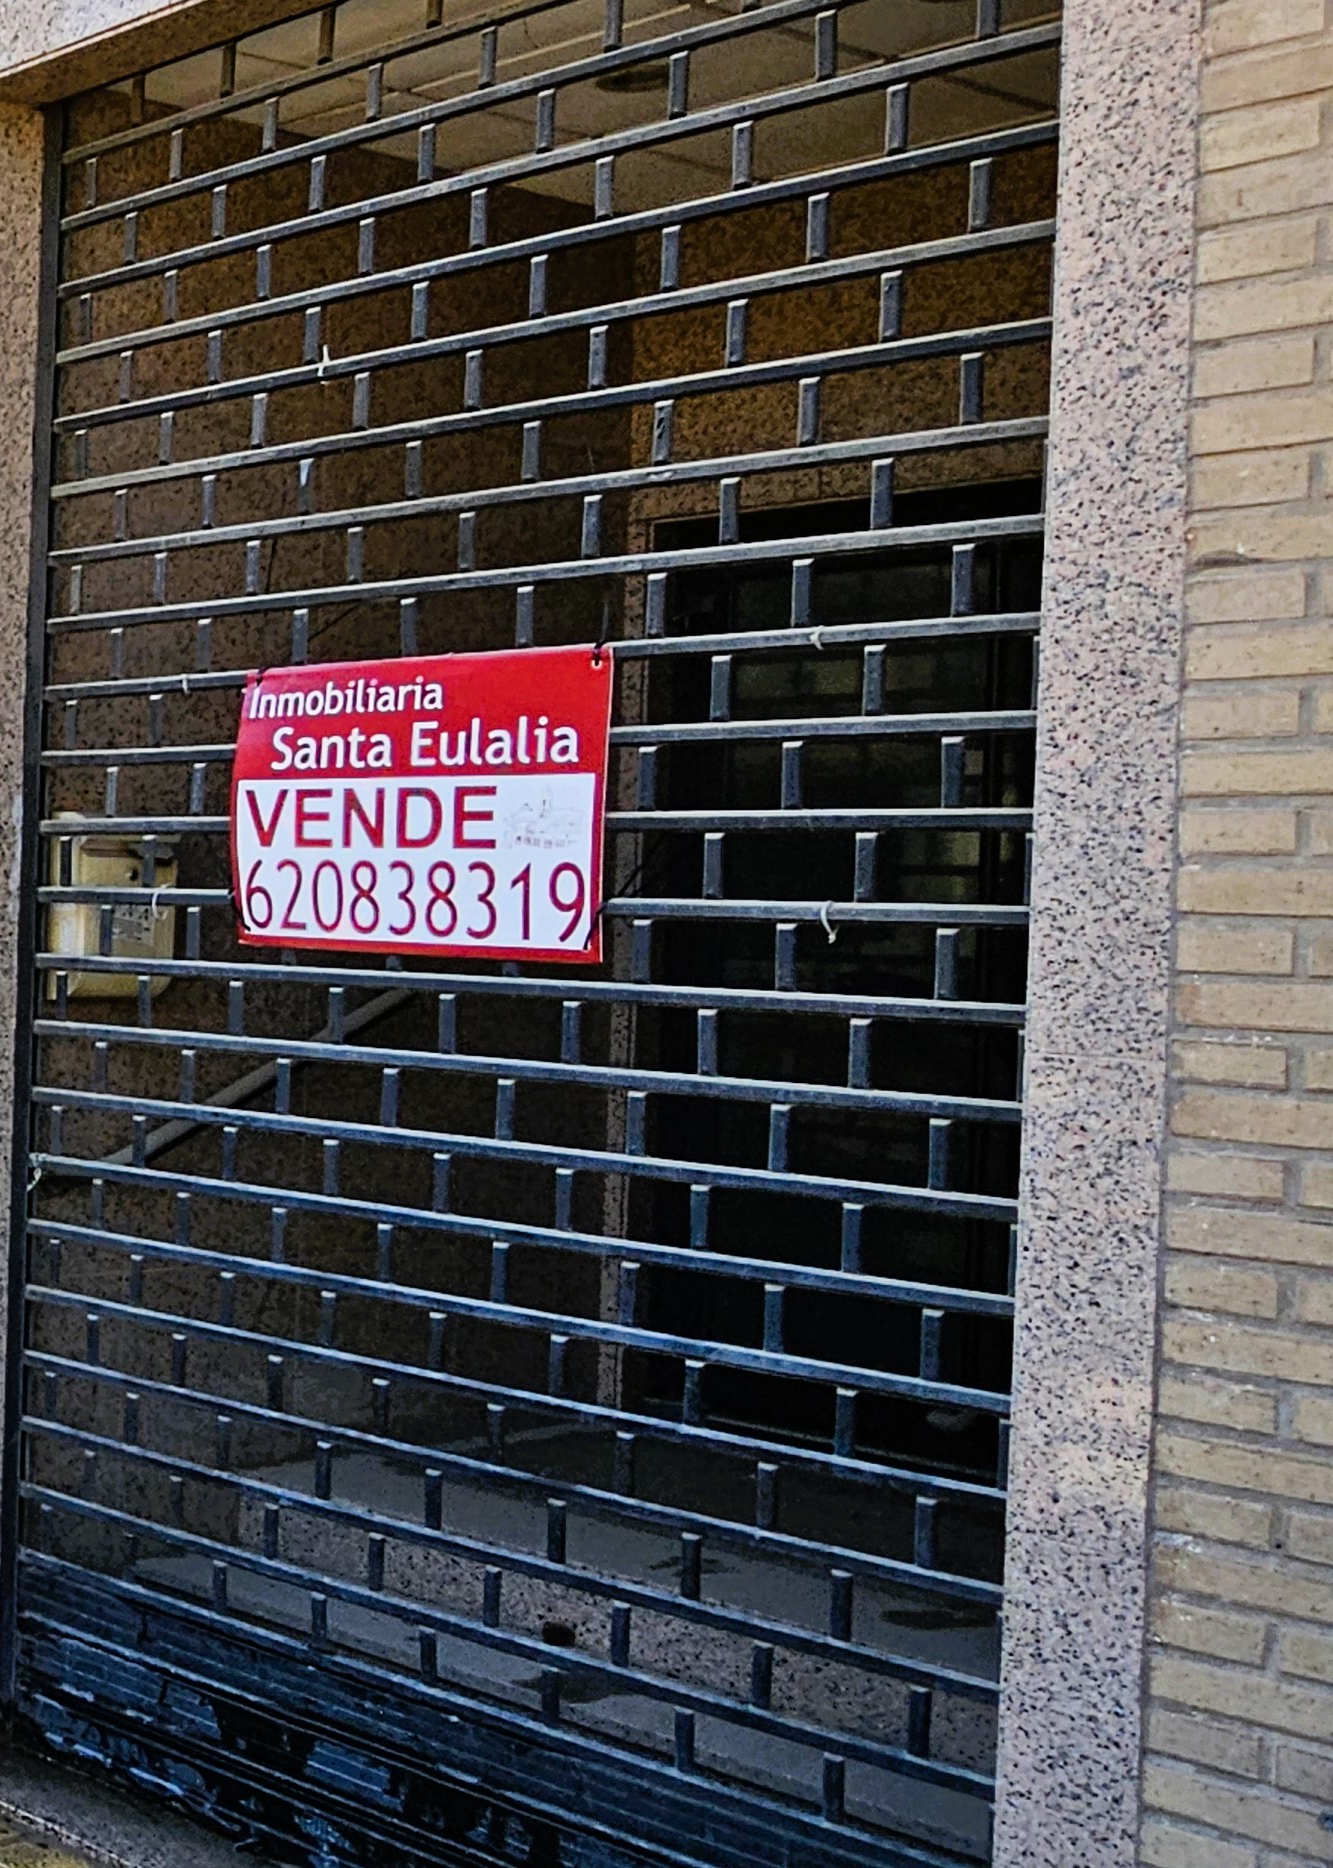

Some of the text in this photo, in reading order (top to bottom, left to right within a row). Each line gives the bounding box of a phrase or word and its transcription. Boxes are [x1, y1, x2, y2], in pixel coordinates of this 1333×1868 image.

[248, 675, 443, 719] Inmobiliaria
[270, 715, 579, 771] Santa Eulalia
[245, 786, 498, 849] VENDE
[245, 859, 585, 942] 620838319
